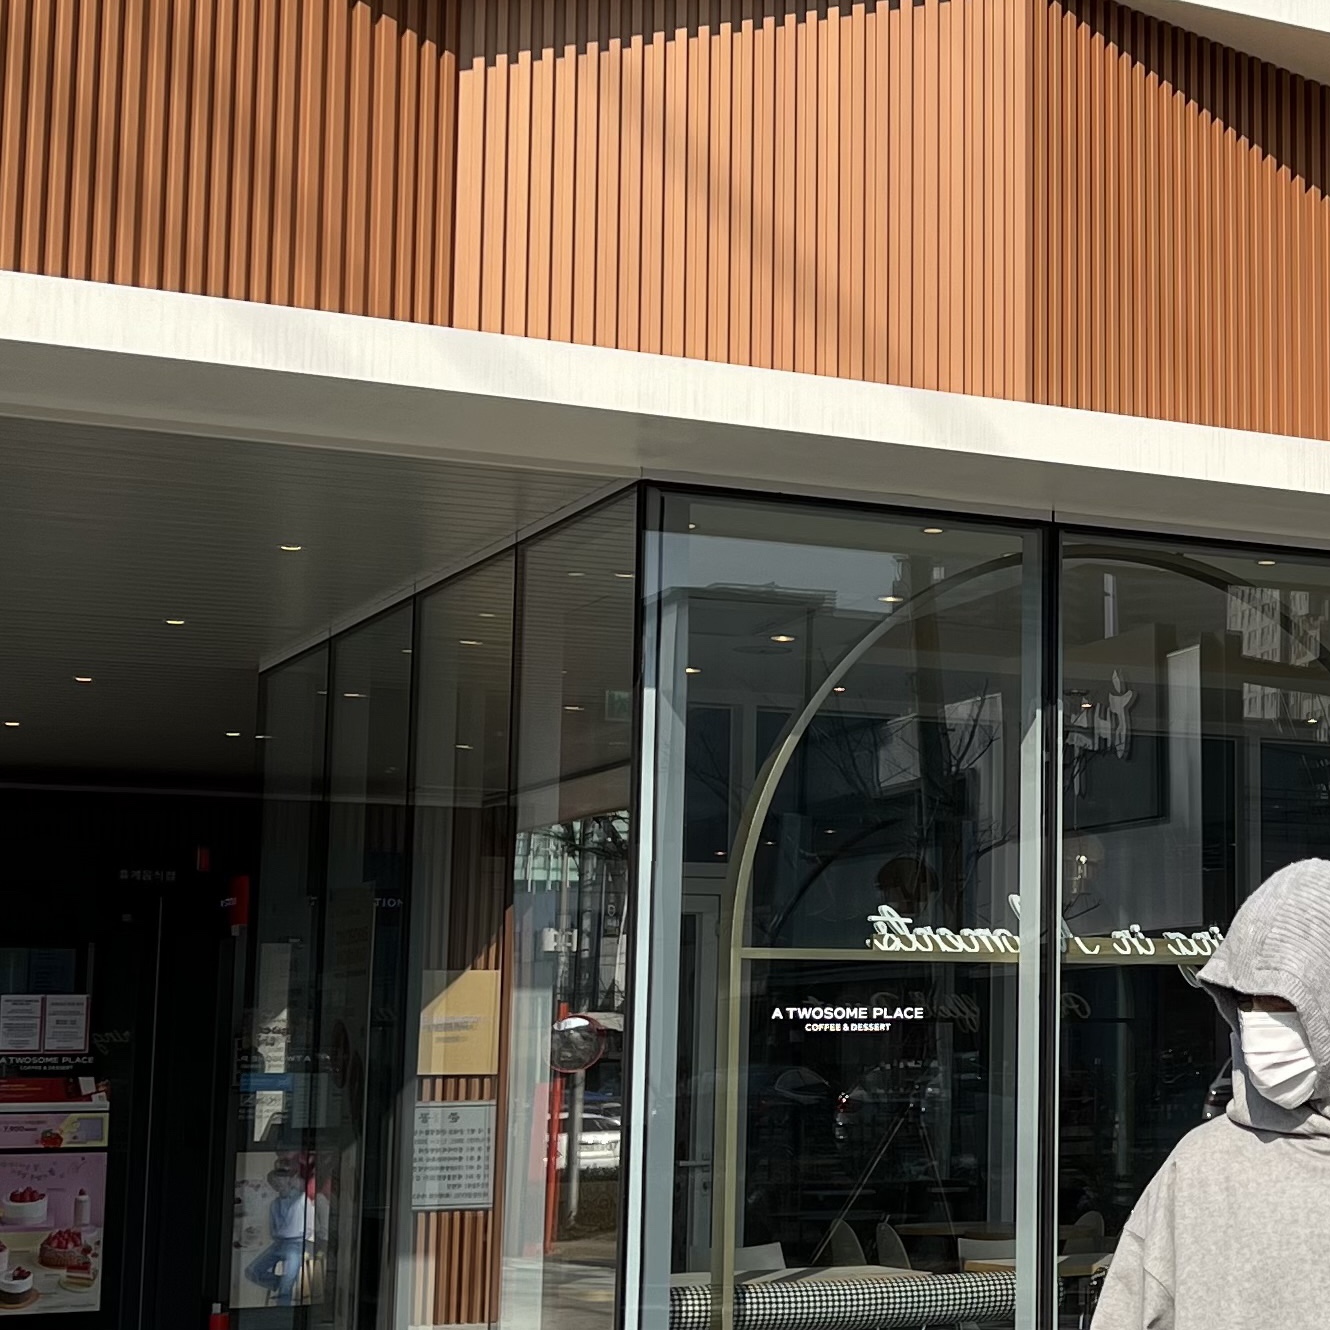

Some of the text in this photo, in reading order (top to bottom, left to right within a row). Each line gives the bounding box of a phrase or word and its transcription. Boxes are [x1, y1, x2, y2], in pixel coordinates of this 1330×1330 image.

[771, 1007, 924, 1020] A TWOSOME PLACE
[805, 1022, 892, 1031] COFFEE & DESSERT
[9, 1056, 59, 1064] TWOSOME
[61, 1056, 95, 1064] PLACE
